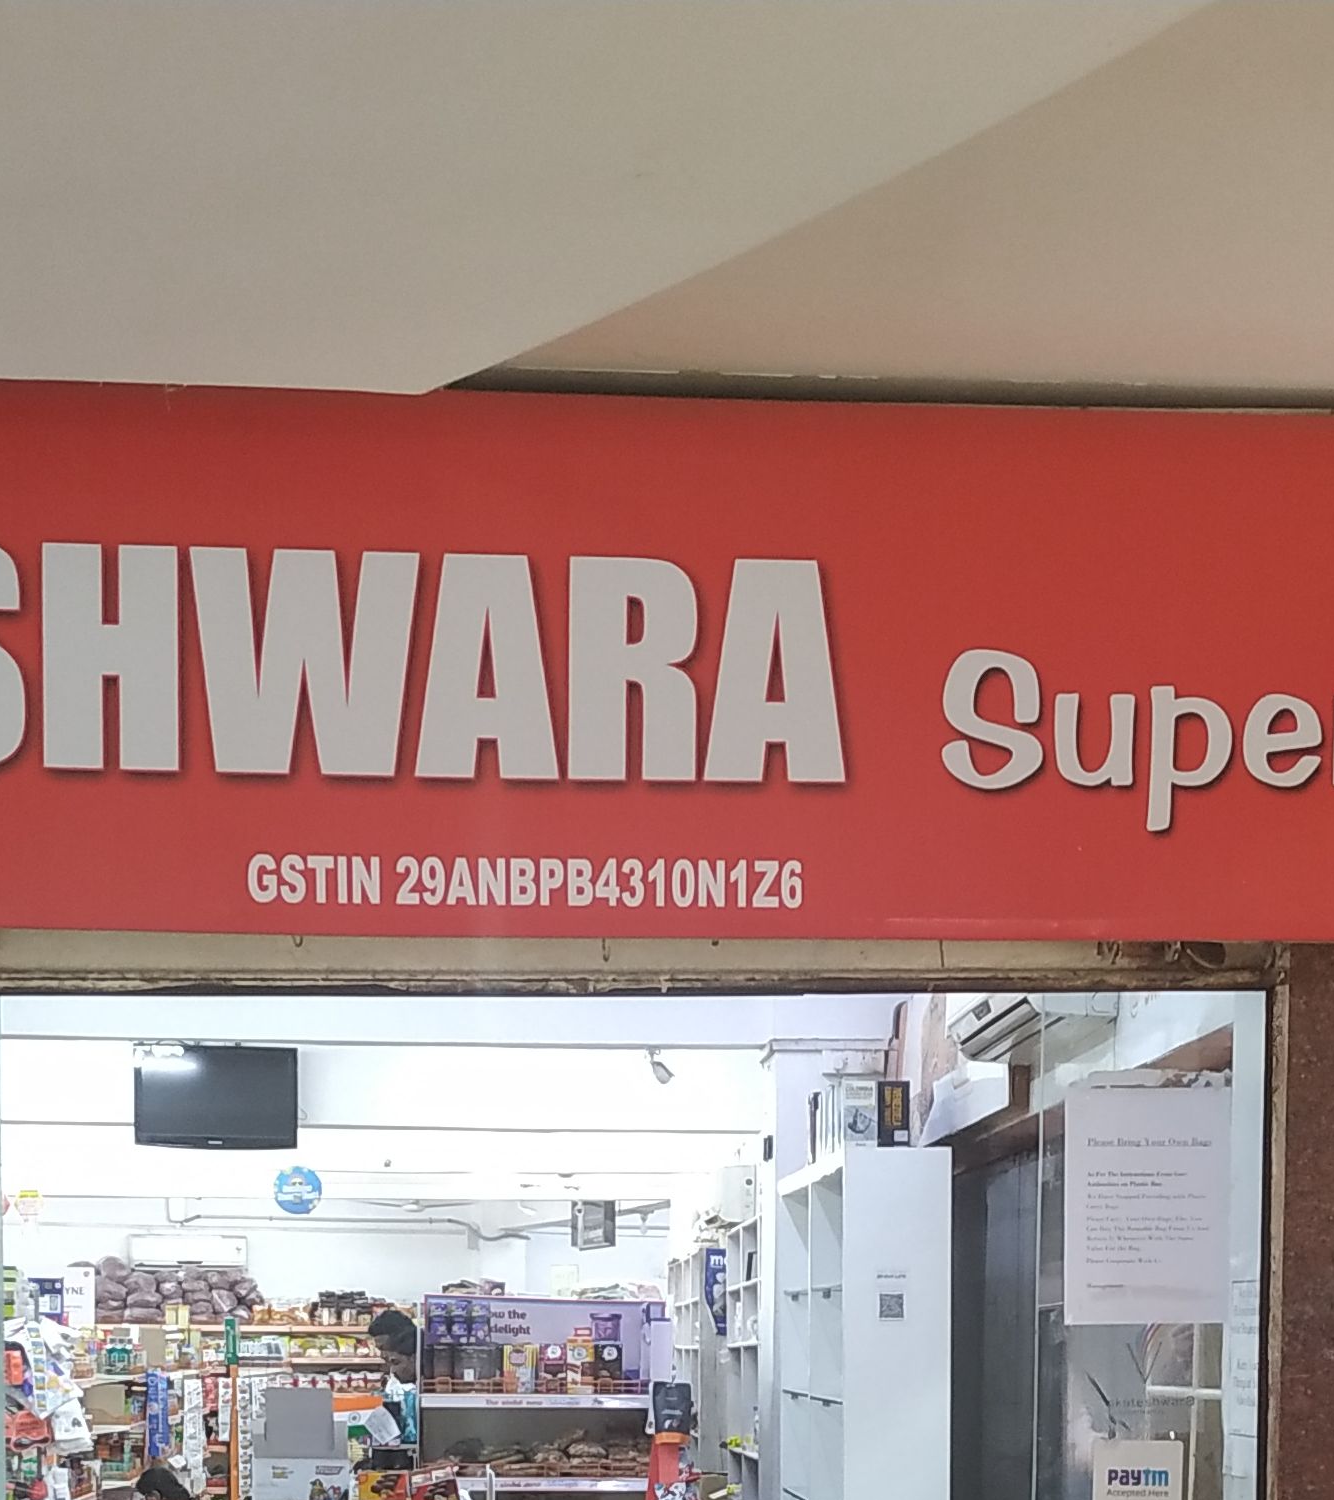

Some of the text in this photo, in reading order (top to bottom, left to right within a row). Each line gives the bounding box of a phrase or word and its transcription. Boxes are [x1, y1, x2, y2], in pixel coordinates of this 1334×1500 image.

[248, 854, 802, 908] GSTIN 29ANBPB4310N1Z6
[1087, 1138, 1114, 1147] Please
[1107, 1489, 1169, 1498] Accepted Here
